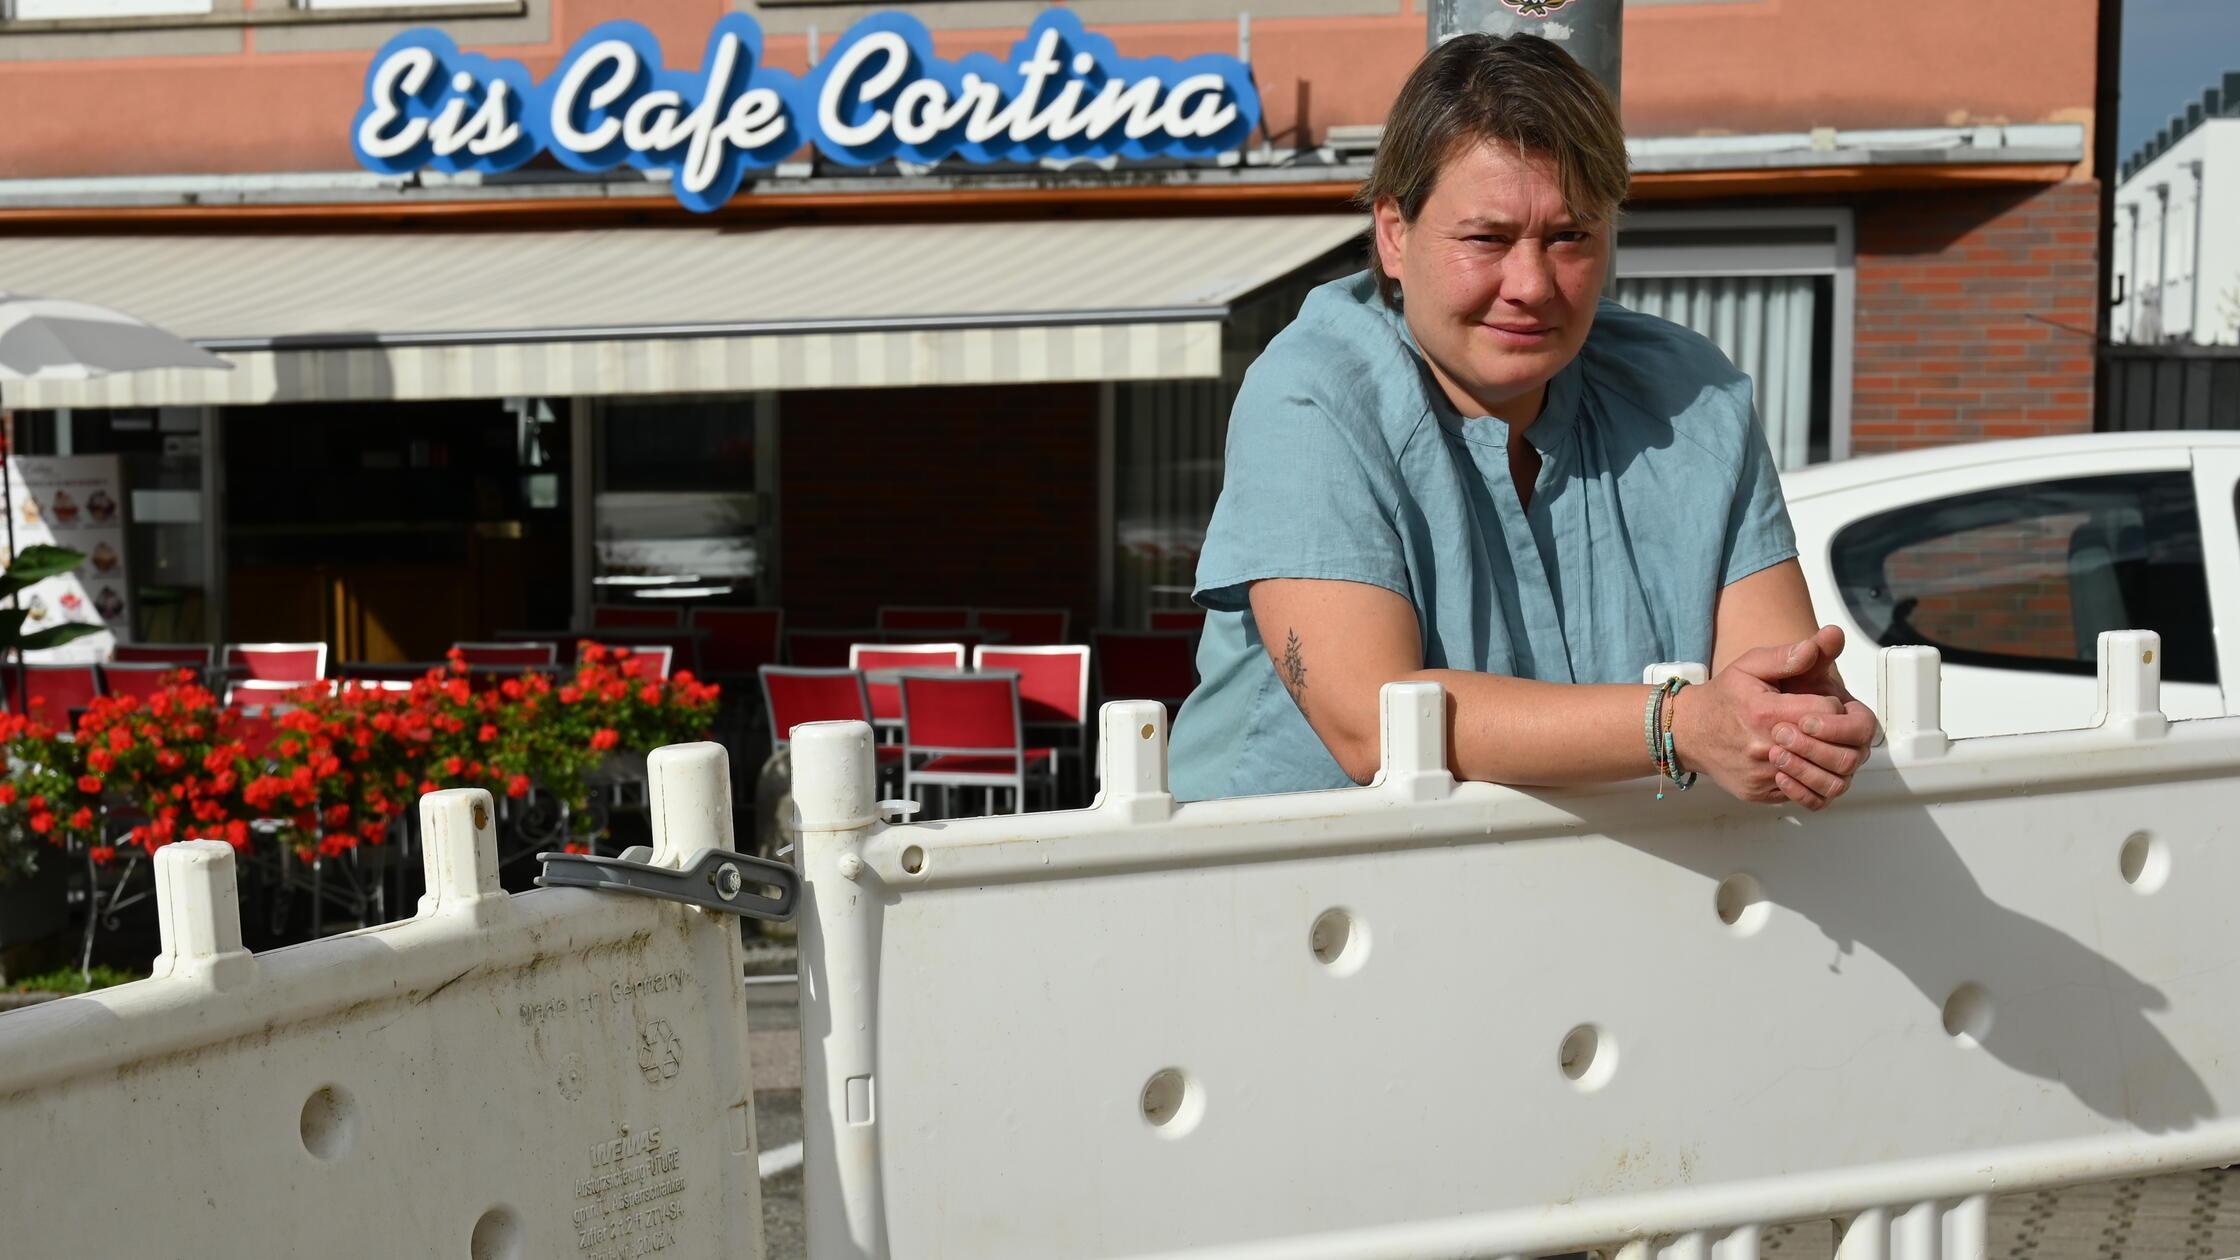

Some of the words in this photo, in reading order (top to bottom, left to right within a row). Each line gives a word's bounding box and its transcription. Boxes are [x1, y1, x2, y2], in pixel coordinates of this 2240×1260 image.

[359, 46, 519, 157] Eis
[551, 31, 786, 193] Cafe
[818, 27, 1238, 146] Cortina
[519, 998, 568, 1026] Made
[610, 968, 686, 1004] Germany
